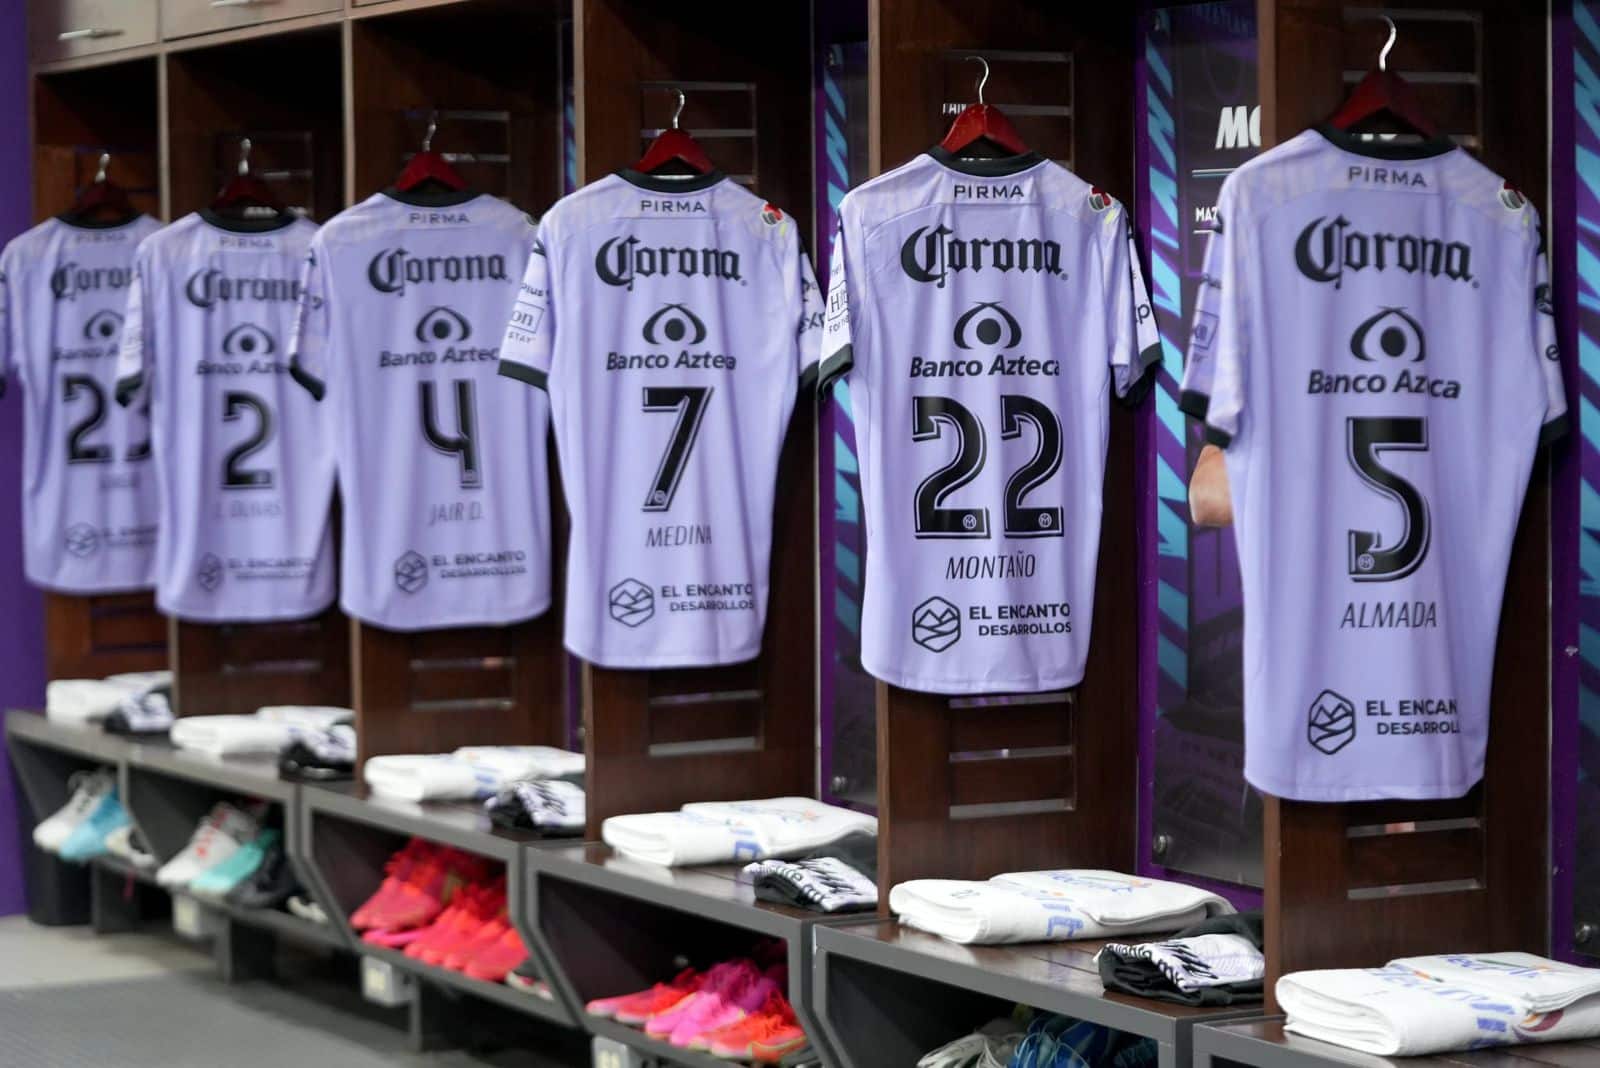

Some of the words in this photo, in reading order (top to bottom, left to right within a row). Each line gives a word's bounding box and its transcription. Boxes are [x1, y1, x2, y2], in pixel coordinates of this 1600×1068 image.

[1347, 165, 1428, 188] PIRMA
[953, 184, 1024, 199] PIRMA
[410, 211, 469, 225] PIRMA
[641, 199, 706, 213] PIRMA
[595, 235, 742, 291] Corona
[900, 224, 1064, 288] Corona
[1295, 215, 1474, 290] Corona
[51, 262, 133, 302] Coro
[368, 248, 507, 297] Corona
[379, 350, 437, 367] Banco
[442, 346, 500, 364] Aztec
[606, 351, 670, 371] Banco
[910, 356, 983, 378] Banco
[1307, 369, 1387, 394] Banco
[222, 390, 274, 491] 2
[419, 379, 483, 489] 4
[642, 386, 715, 512] 7
[912, 394, 1064, 539] 22
[1346, 416, 1431, 582] 5
[946, 551, 1036, 580] MONTAÑO
[661, 585, 681, 597] EL
[969, 605, 992, 620] EL
[998, 603, 1071, 619] ENCANTO
[1340, 602, 1438, 629] ALMADA
[978, 621, 1072, 636] DESARROLLOS
[1366, 700, 1392, 716] EL
[1399, 700, 1457, 716] ENCAN
